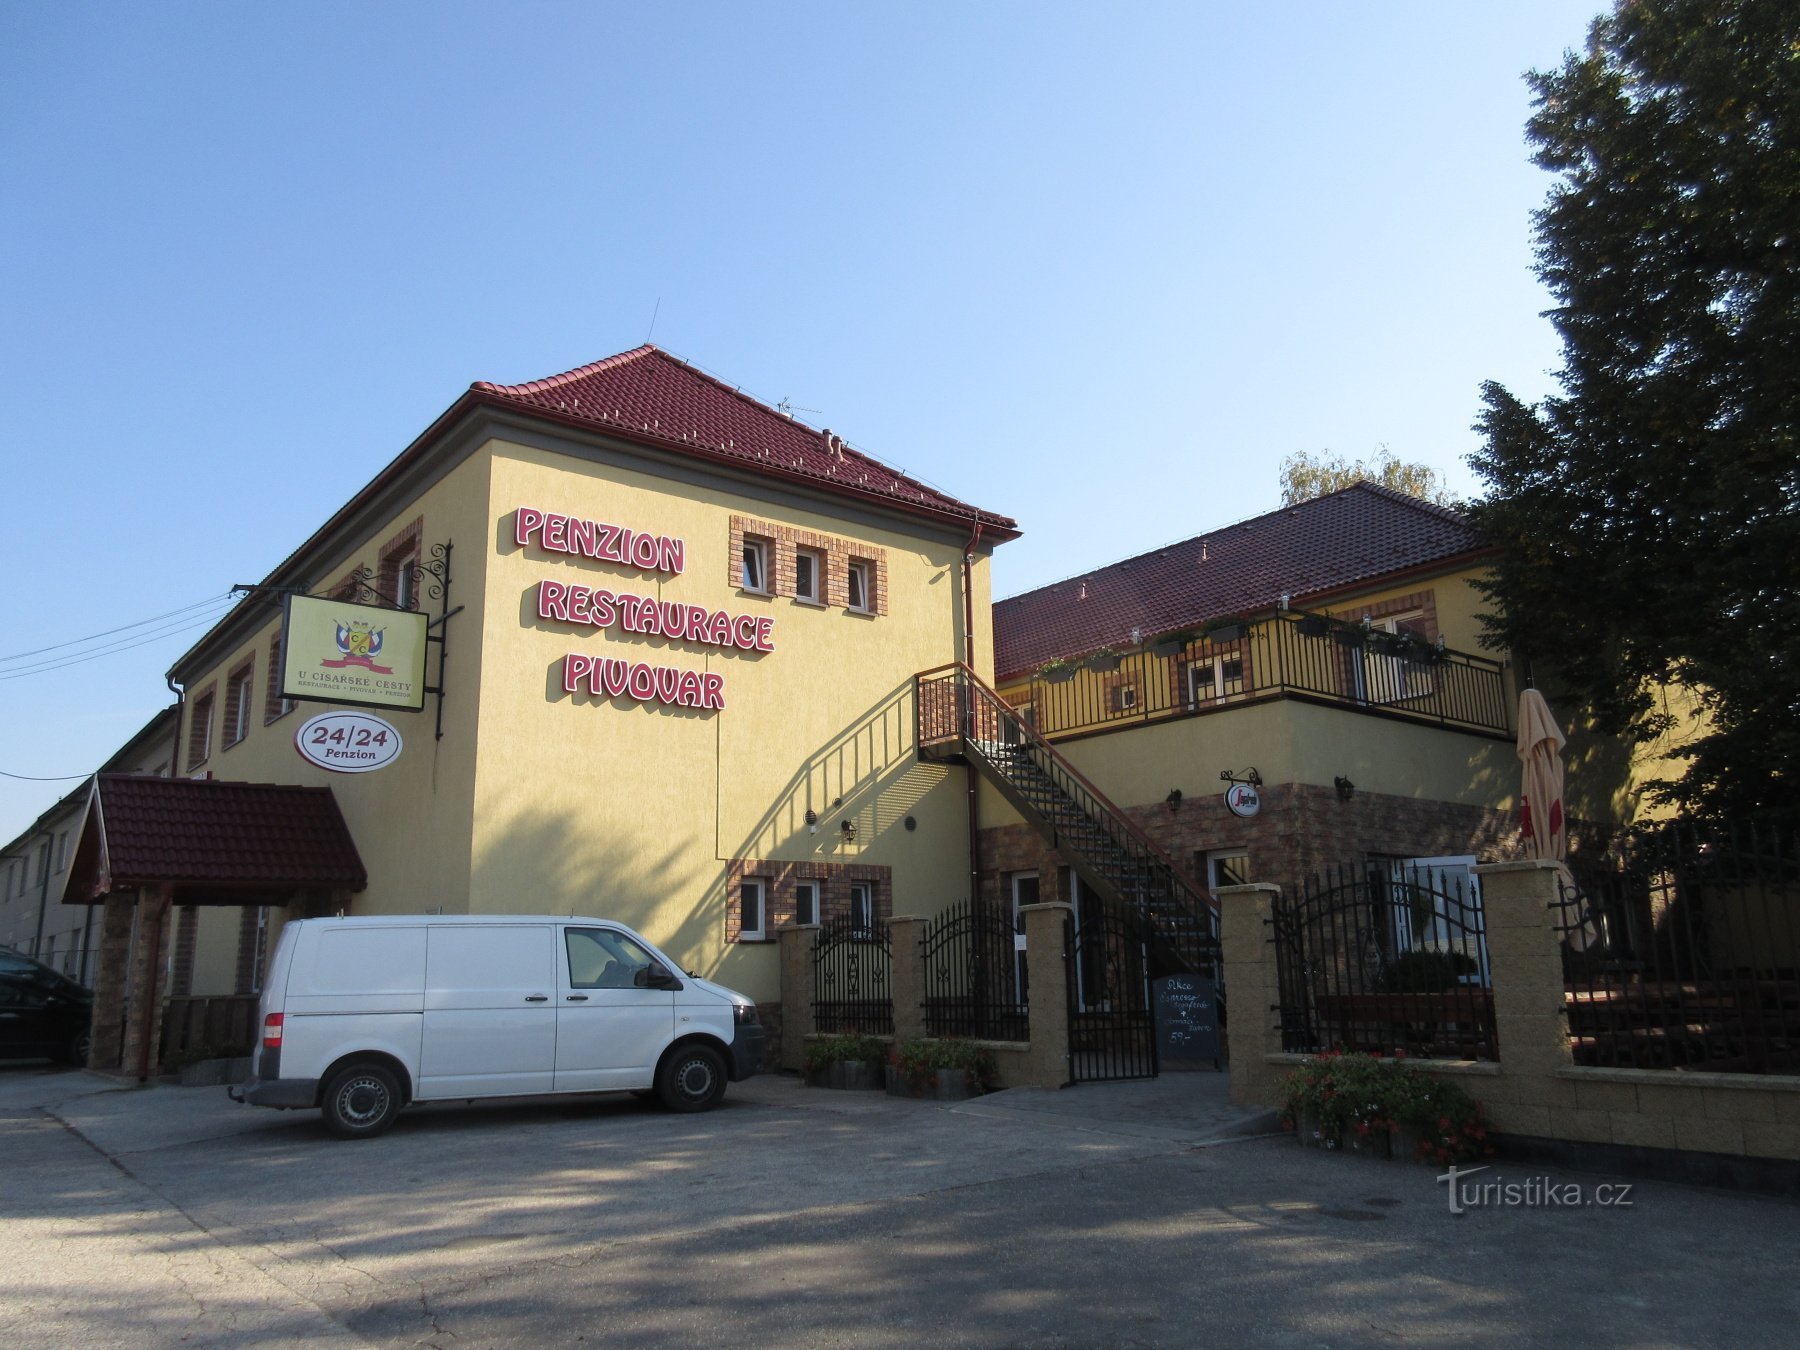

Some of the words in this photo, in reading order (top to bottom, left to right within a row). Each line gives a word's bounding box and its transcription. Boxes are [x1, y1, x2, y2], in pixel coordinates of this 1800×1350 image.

[515, 507, 685, 573] PENZION
[538, 580, 775, 651] RESTAURACE
[298, 671, 307, 679] U
[376, 680, 412, 691] CESTY
[298, 680, 340, 690] RESTAURACE
[563, 653, 725, 709] PIVOVAR
[311, 725, 388, 748] 24/24
[325, 748, 376, 760] Penzion
[1168, 979, 1193, 990] Akce
